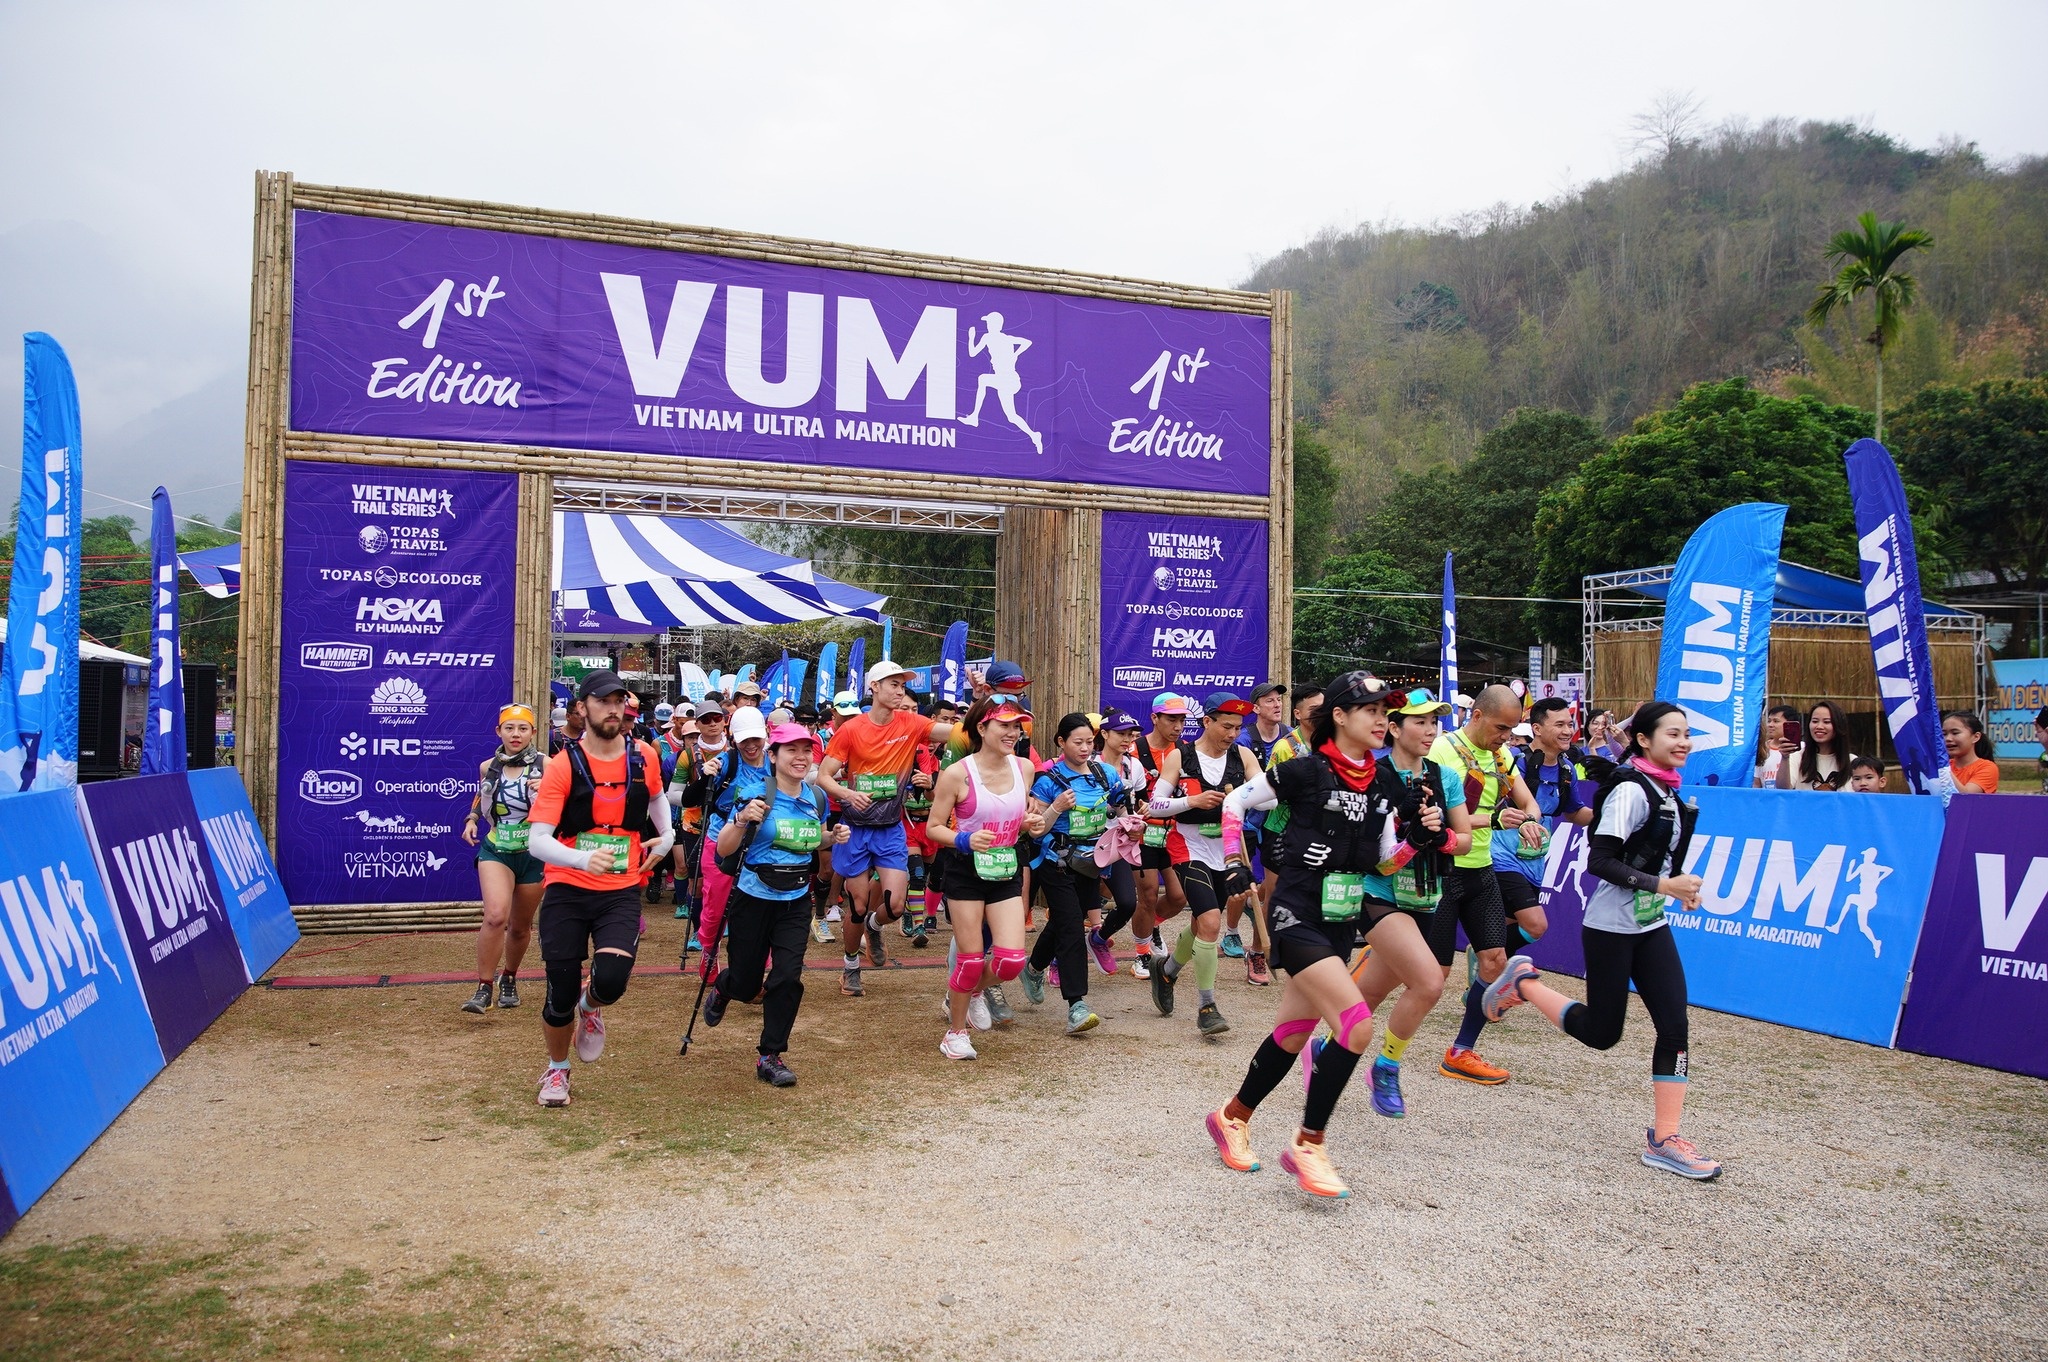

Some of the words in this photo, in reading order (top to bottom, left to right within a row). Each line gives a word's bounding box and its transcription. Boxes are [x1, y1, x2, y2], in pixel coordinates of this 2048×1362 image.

[398, 276, 506, 349] 1st
[600, 272, 957, 420] VUM
[367, 354, 522, 408] Edition
[1130, 347, 1210, 410] 1st
[634, 403, 743, 433] VIETNAM
[754, 413, 825, 438] ULTRA
[836, 419, 956, 447] MARATHON
[1109, 415, 1224, 461] Edition
[352, 484, 437, 504] VIETNAM
[352, 501, 390, 516] TRAIL
[391, 503, 437, 518] SERIES
[391, 526, 440, 538] TOPAS
[1148, 532, 1210, 548] VIETNAM
[390, 538, 448, 550] TRAVEL
[1888, 513, 1904, 589] MARATHON
[1148, 546, 1176, 558] TRAIL
[1176, 548, 1210, 560] SERIES
[320, 569, 373, 582] TOPAS
[399, 572, 482, 586] ECOLODGE
[1176, 568, 1212, 578] TOPAS
[1176, 578, 1218, 589] TRAVEL
[356, 597, 445, 622] HOKA
[1126, 604, 1164, 614] TOPAS
[1182, 607, 1244, 618] ECOLODGE
[1898, 592, 1908, 636] ULTRA
[356, 622, 376, 632] FLY
[376, 624, 422, 634] HUMAN
[423, 625, 444, 634] FLY
[1738, 590, 1754, 652] MARATHON
[1152, 627, 1218, 650] HOKA
[306, 648, 368, 661] HAMMER
[580, 658, 610, 668] VUM
[1152, 650, 1166, 658] FLY
[1168, 650, 1200, 659] HUMAN
[1202, 651, 1216, 660] FLY
[1116, 670, 1162, 682] HAMMER
[1676, 582, 1742, 754] VUM
[1734, 656, 1746, 692] ULTRA
[1904, 640, 1920, 703] VIETNAM
[379, 716, 418, 728] Hospital
[1732, 696, 1744, 747] VIETNAM
[373, 738, 420, 756] IRC
[375, 780, 438, 796] Operation
[458, 780, 480, 794] Smi
[388, 822, 412, 834] blue
[414, 822, 452, 838] dragon
[780, 826, 794, 834] VUM
[798, 828, 817, 838] 2753
[982, 822, 1000, 833] YOU
[201, 811, 262, 891] VUM
[580, 840, 598, 849] VUM
[344, 845, 426, 862] newborns
[344, 863, 426, 878] VIETNAM
[112, 828, 204, 940] VUM
[1327, 884, 1346, 893] VUM
[1397, 876, 1416, 884] VUM
[150, 936, 174, 964] VIETNAM
[171, 928, 189, 950] ULTRA
[186, 916, 208, 941] MARATHON
[1704, 918, 1742, 936] ULTRA
[1746, 924, 1823, 949] MARATHON
[0, 1022, 39, 1067] VIETNAM
[36, 1005, 66, 1039] ULTRA
[62, 981, 99, 1022] MARATHON
